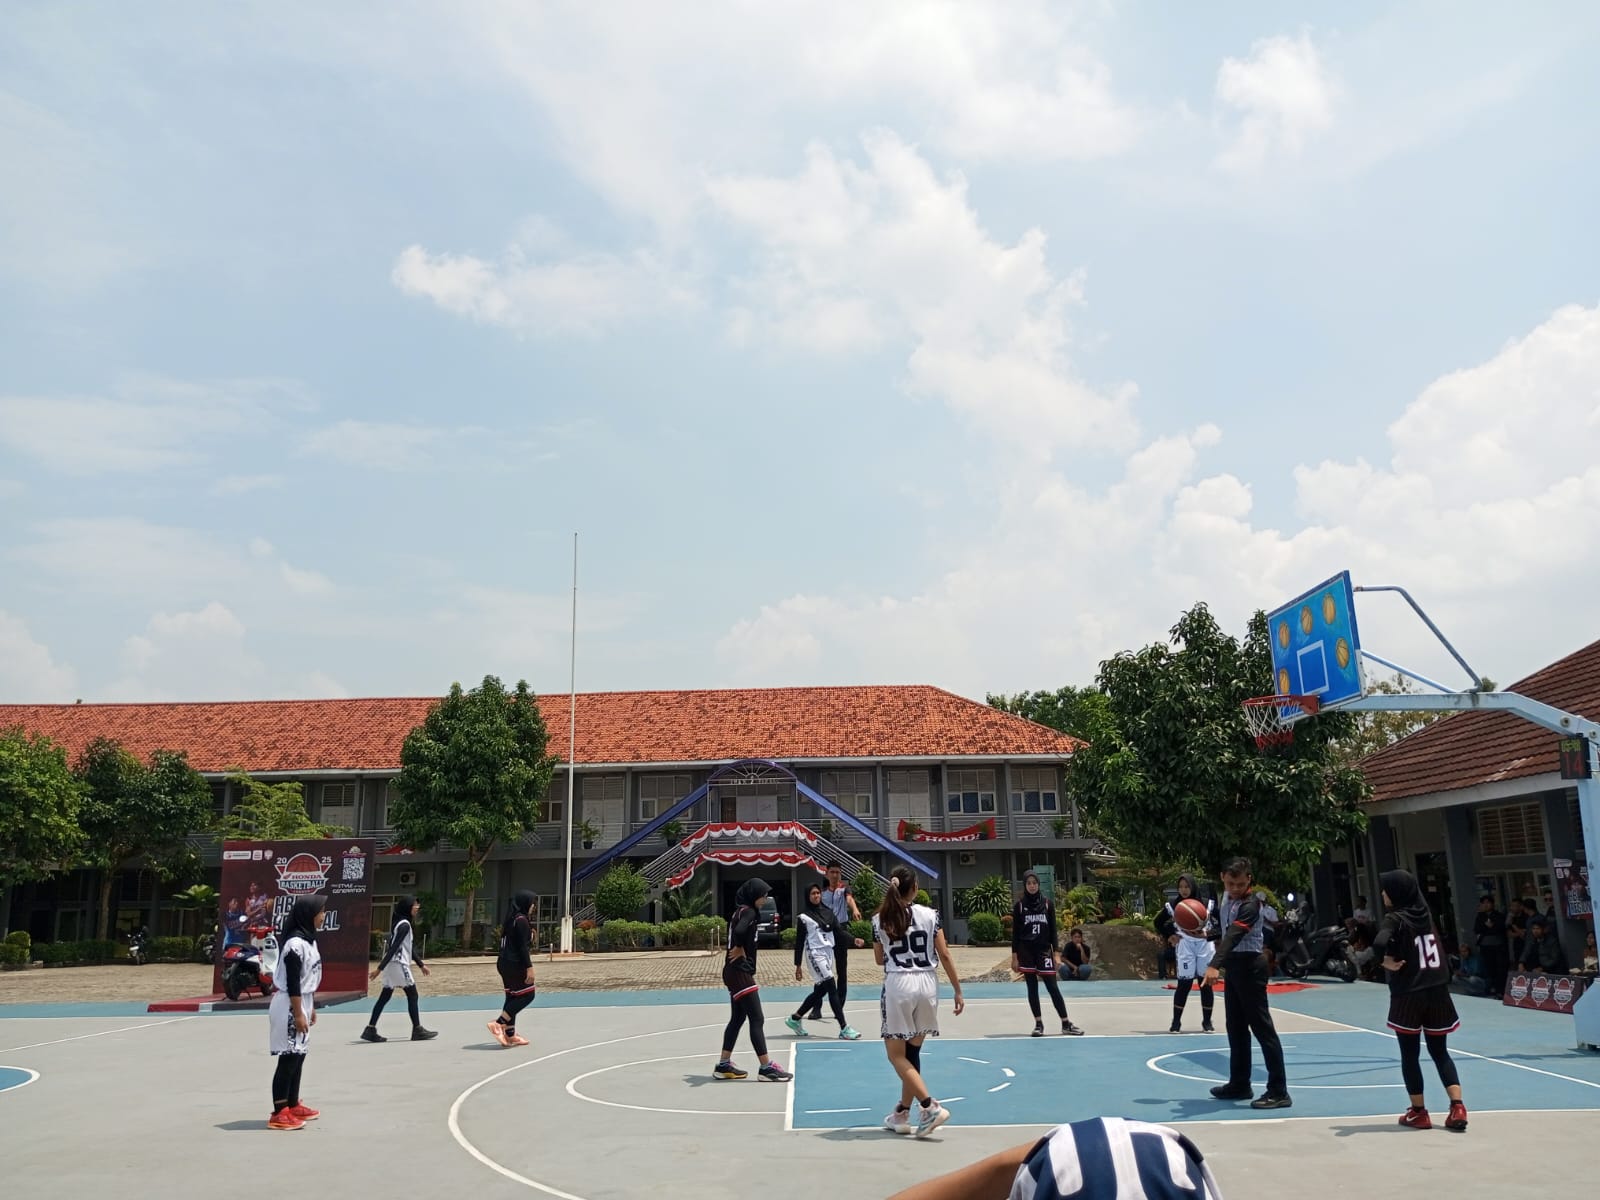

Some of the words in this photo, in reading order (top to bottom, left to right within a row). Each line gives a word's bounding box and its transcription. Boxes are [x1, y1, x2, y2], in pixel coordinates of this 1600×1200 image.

[281, 880, 323, 890] BASKETBALL
[1024, 913, 1048, 925] SMANDA
[1032, 924, 1040, 934] 21
[889, 930, 931, 968] 29
[1414, 934, 1440, 969] 15
[1044, 957, 1053, 968] 21
